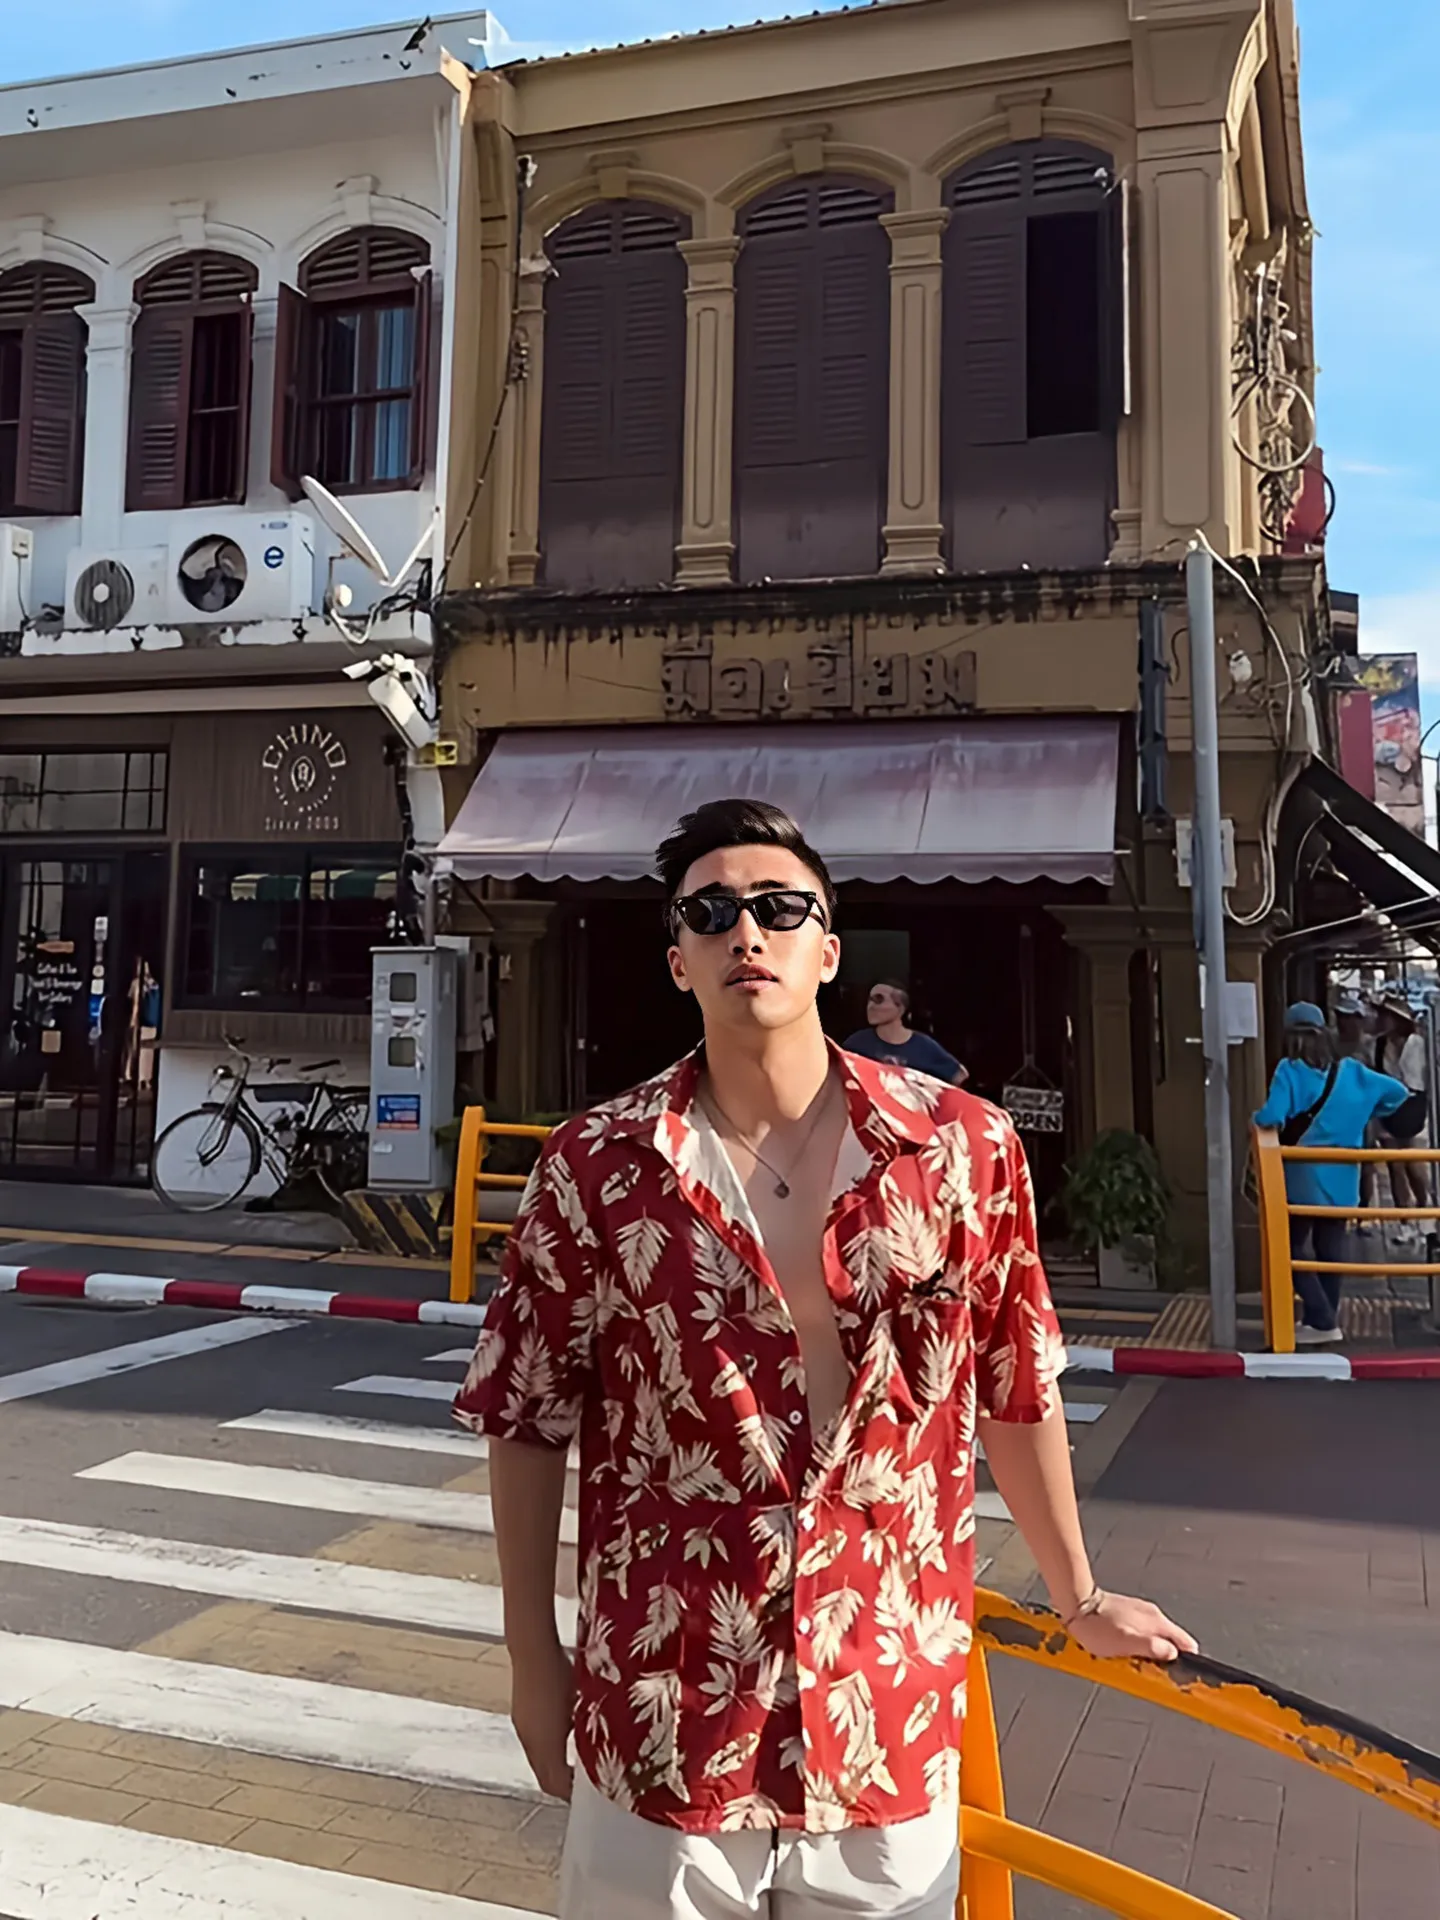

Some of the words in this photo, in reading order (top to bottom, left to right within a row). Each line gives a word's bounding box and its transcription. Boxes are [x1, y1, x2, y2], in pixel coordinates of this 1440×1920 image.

[264, 545, 285, 569] e
[262, 723, 347, 769] CHINO
[1013, 1110, 1062, 1132] OPEN
